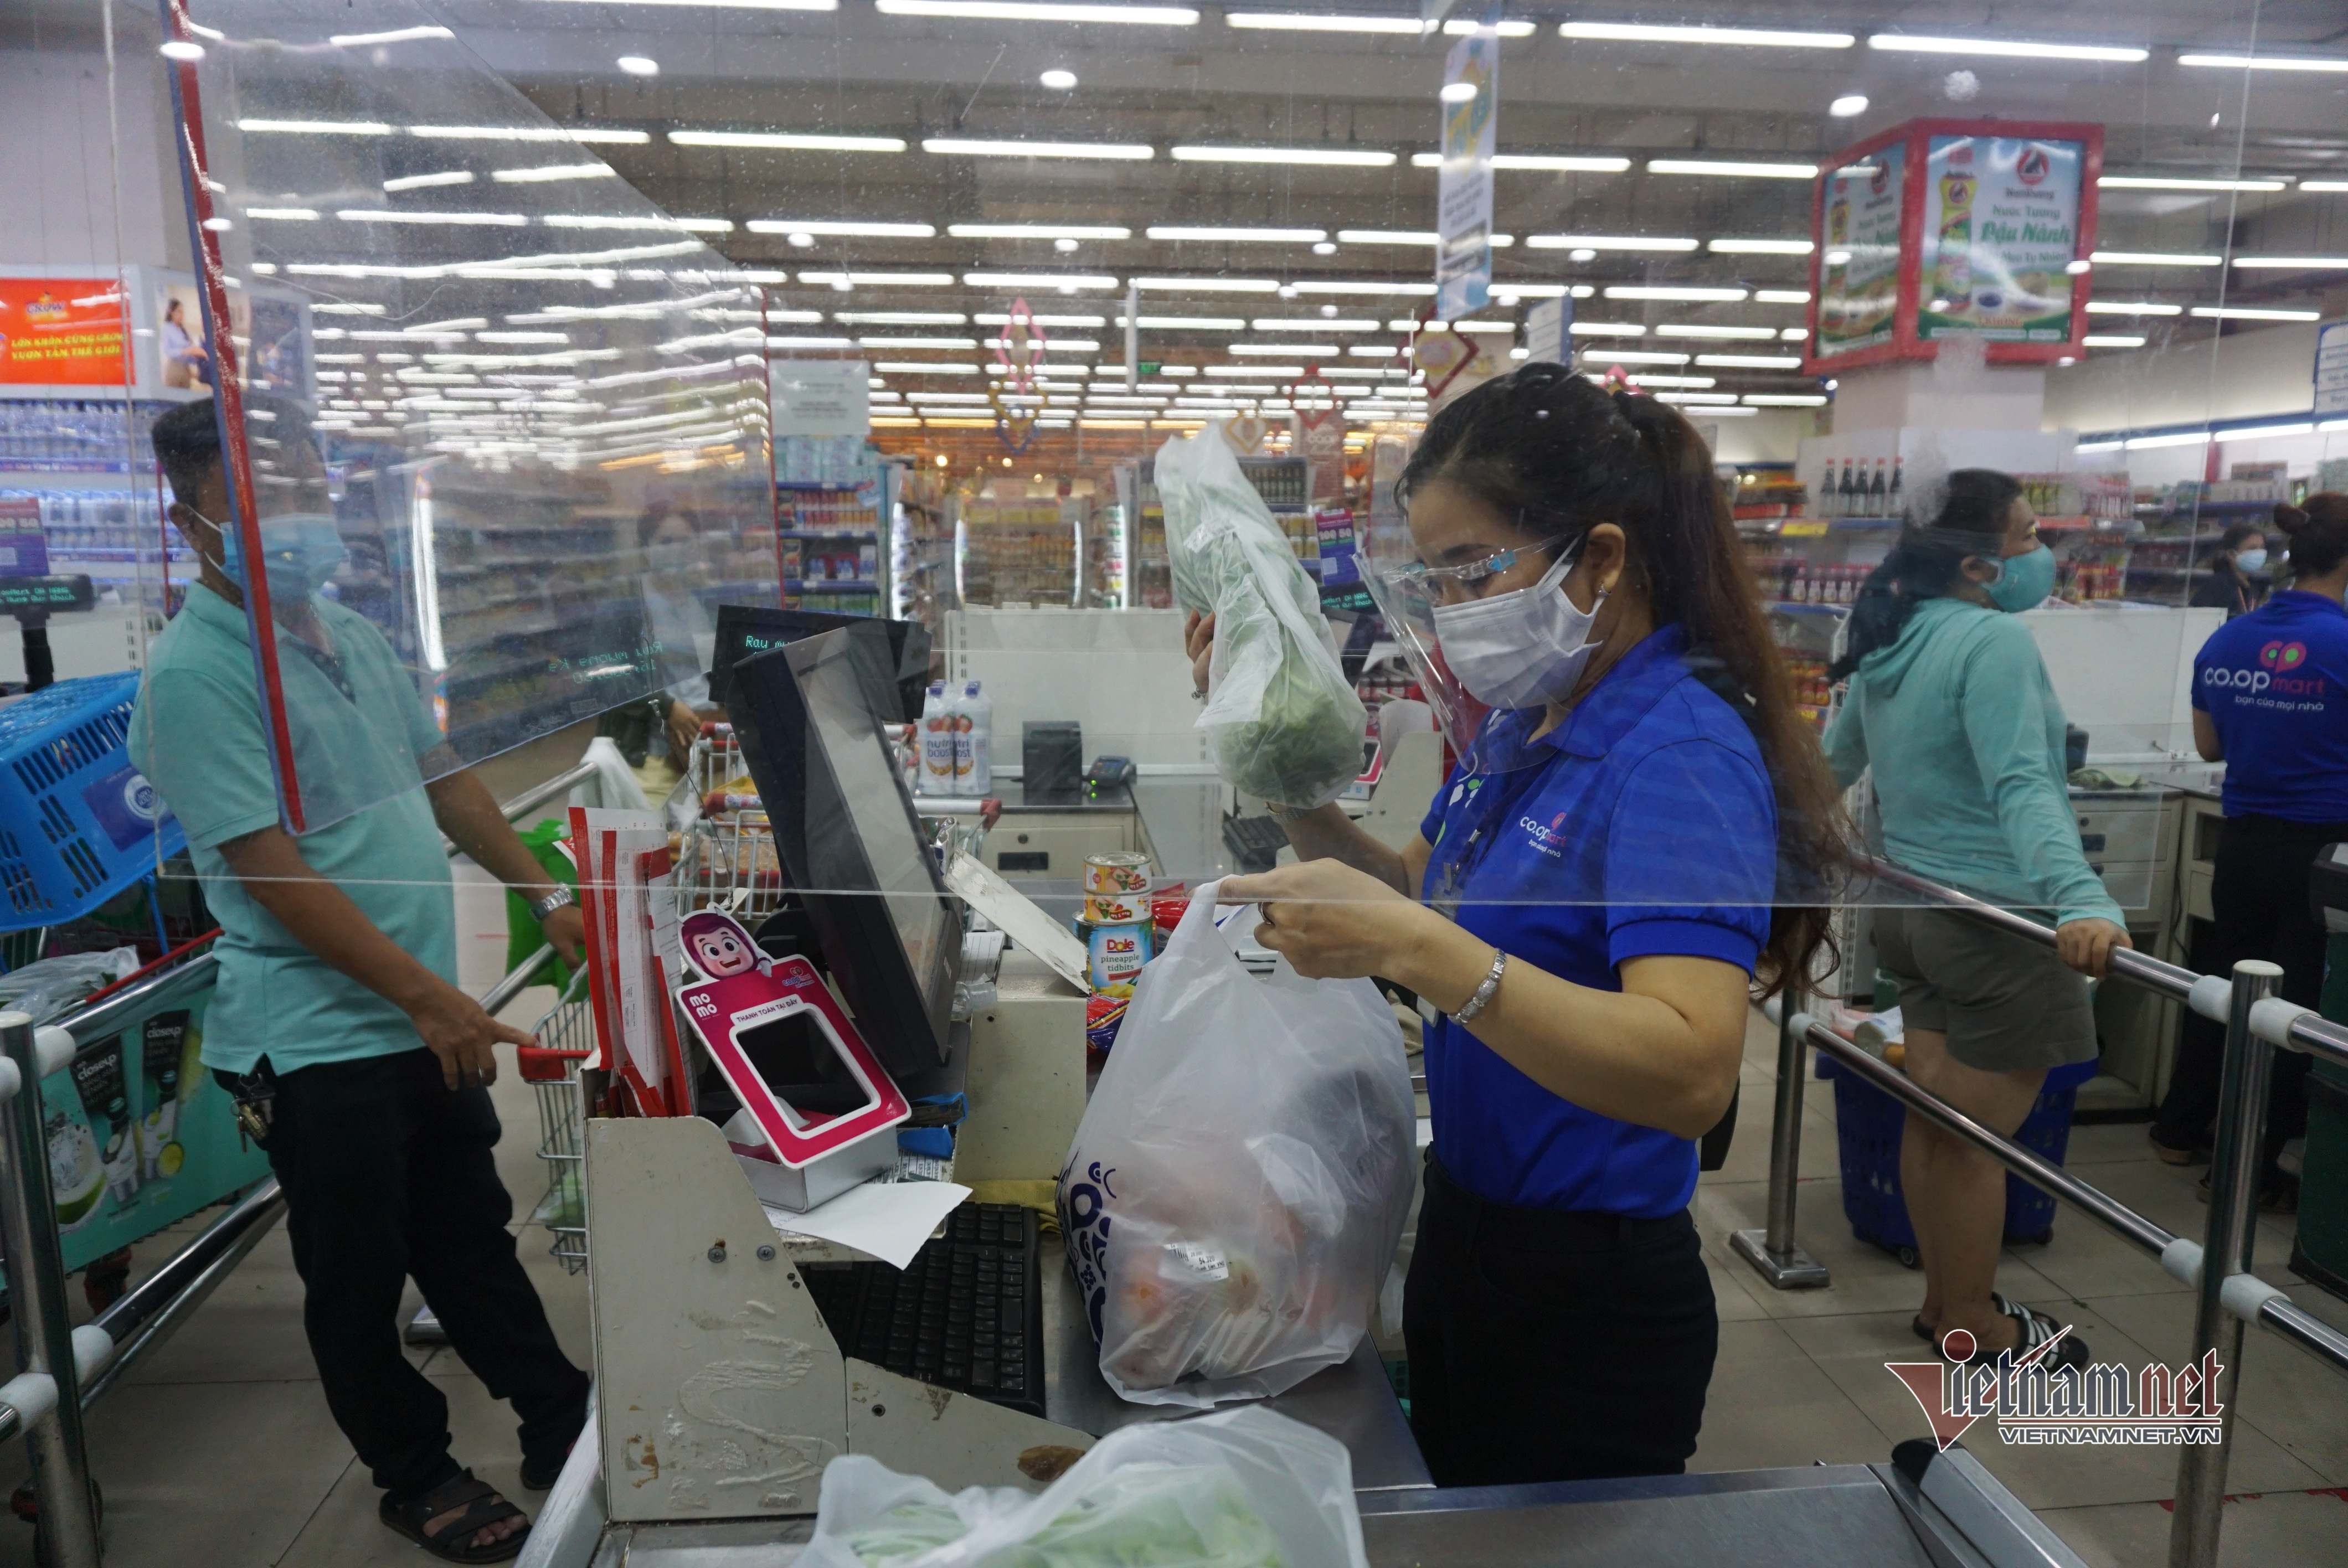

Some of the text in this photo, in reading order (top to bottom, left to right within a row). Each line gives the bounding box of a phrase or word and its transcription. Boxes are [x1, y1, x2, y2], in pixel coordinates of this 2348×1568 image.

[1354, 592, 1368, 600] NANG
[746, 635, 768, 648] Rau
[2235, 694, 2254, 706] bạn
[2257, 697, 2275, 708] của
[2277, 702, 2295, 711] mọi
[1106, 938, 1135, 951] Dole
[1100, 954, 1140, 964] pineapple
[736, 1012, 758, 1023] THANH
[758, 1006, 776, 1017] TOÁN
[786, 998, 799, 1007] ĐÂY
[147, 1026, 181, 1039] closeup
[78, 1054, 117, 1080] closeup
